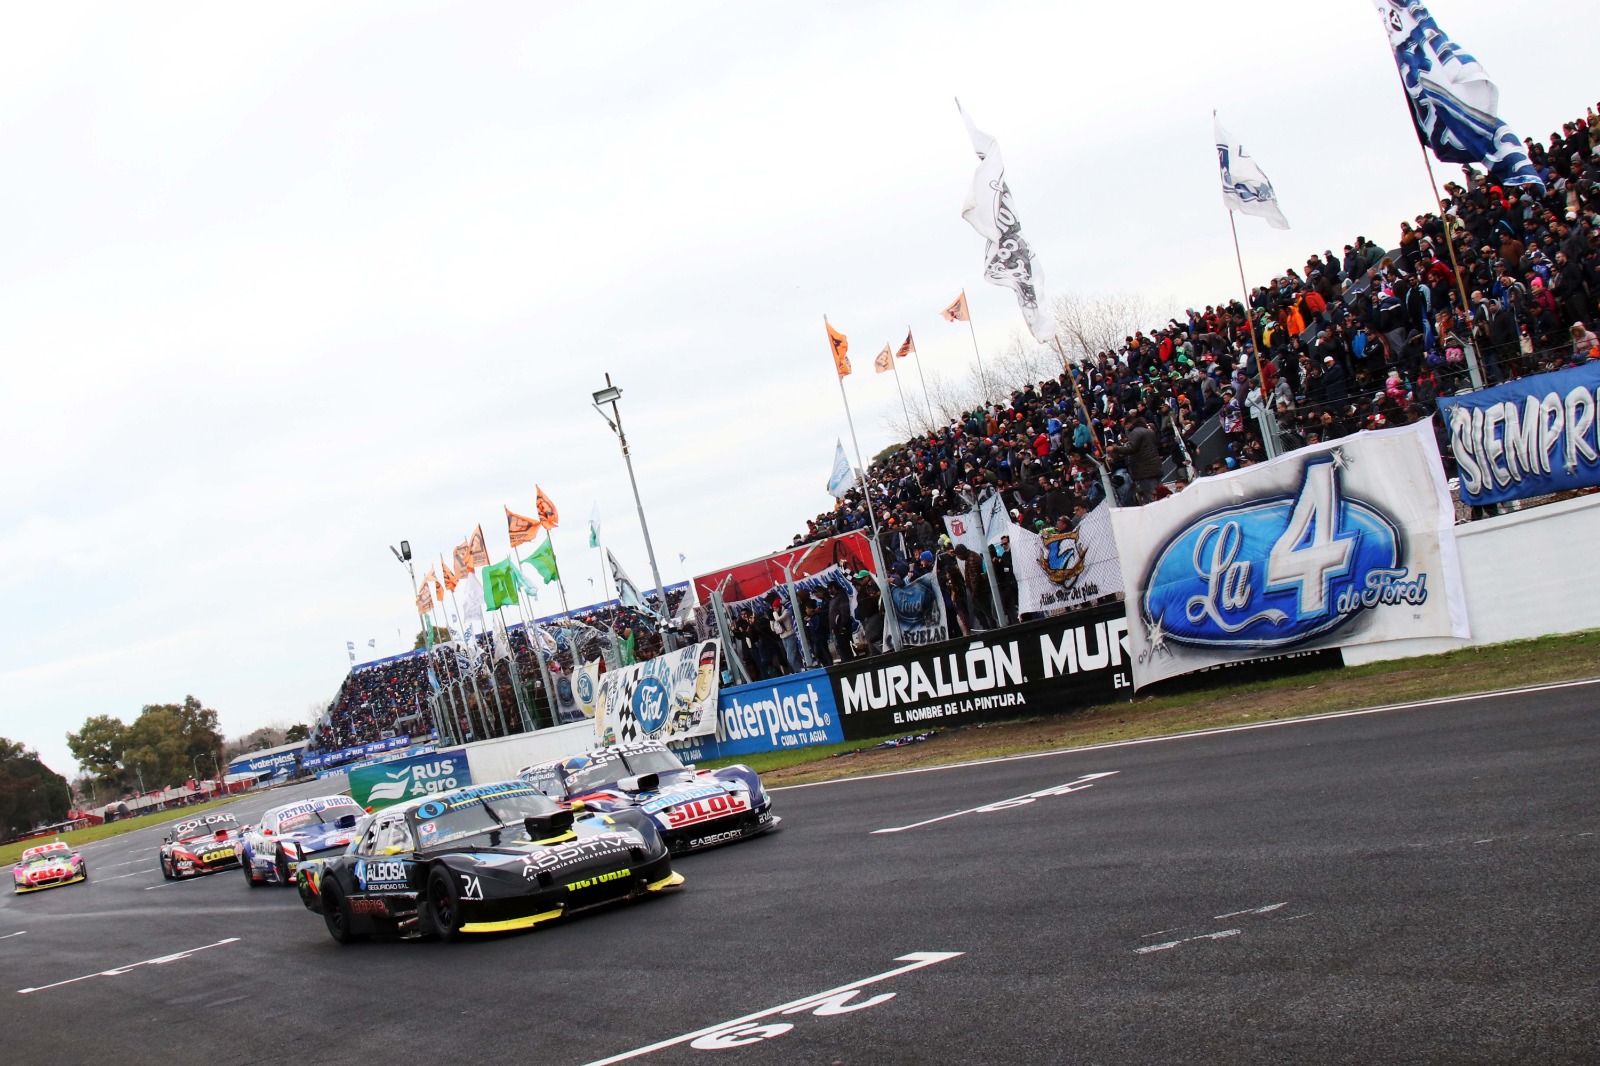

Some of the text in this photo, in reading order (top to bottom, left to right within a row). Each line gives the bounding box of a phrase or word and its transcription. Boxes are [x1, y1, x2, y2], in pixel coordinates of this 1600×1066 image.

[1450, 386, 1600, 495] SIEMPR
[1186, 460, 1428, 633] La 4 de Ford
[841, 641, 1024, 714] MURALLÓN
[893, 692, 1026, 724] EL NOMBRE DE LA PINTURA
[780, 730, 828, 747] CUIDA TU AGUA
[591, 740, 663, 759] casa
[596, 746, 667, 764] del audio
[411, 759, 454, 781] RUS
[410, 777, 457, 797] Agro
[446, 784, 509, 805] TECNOSEG
[279, 797, 354, 822] PETRO URCO
[177, 814, 237, 833] COLCAR
[690, 829, 742, 848] SABECORT
[367, 862, 406, 881] ALBOSA
